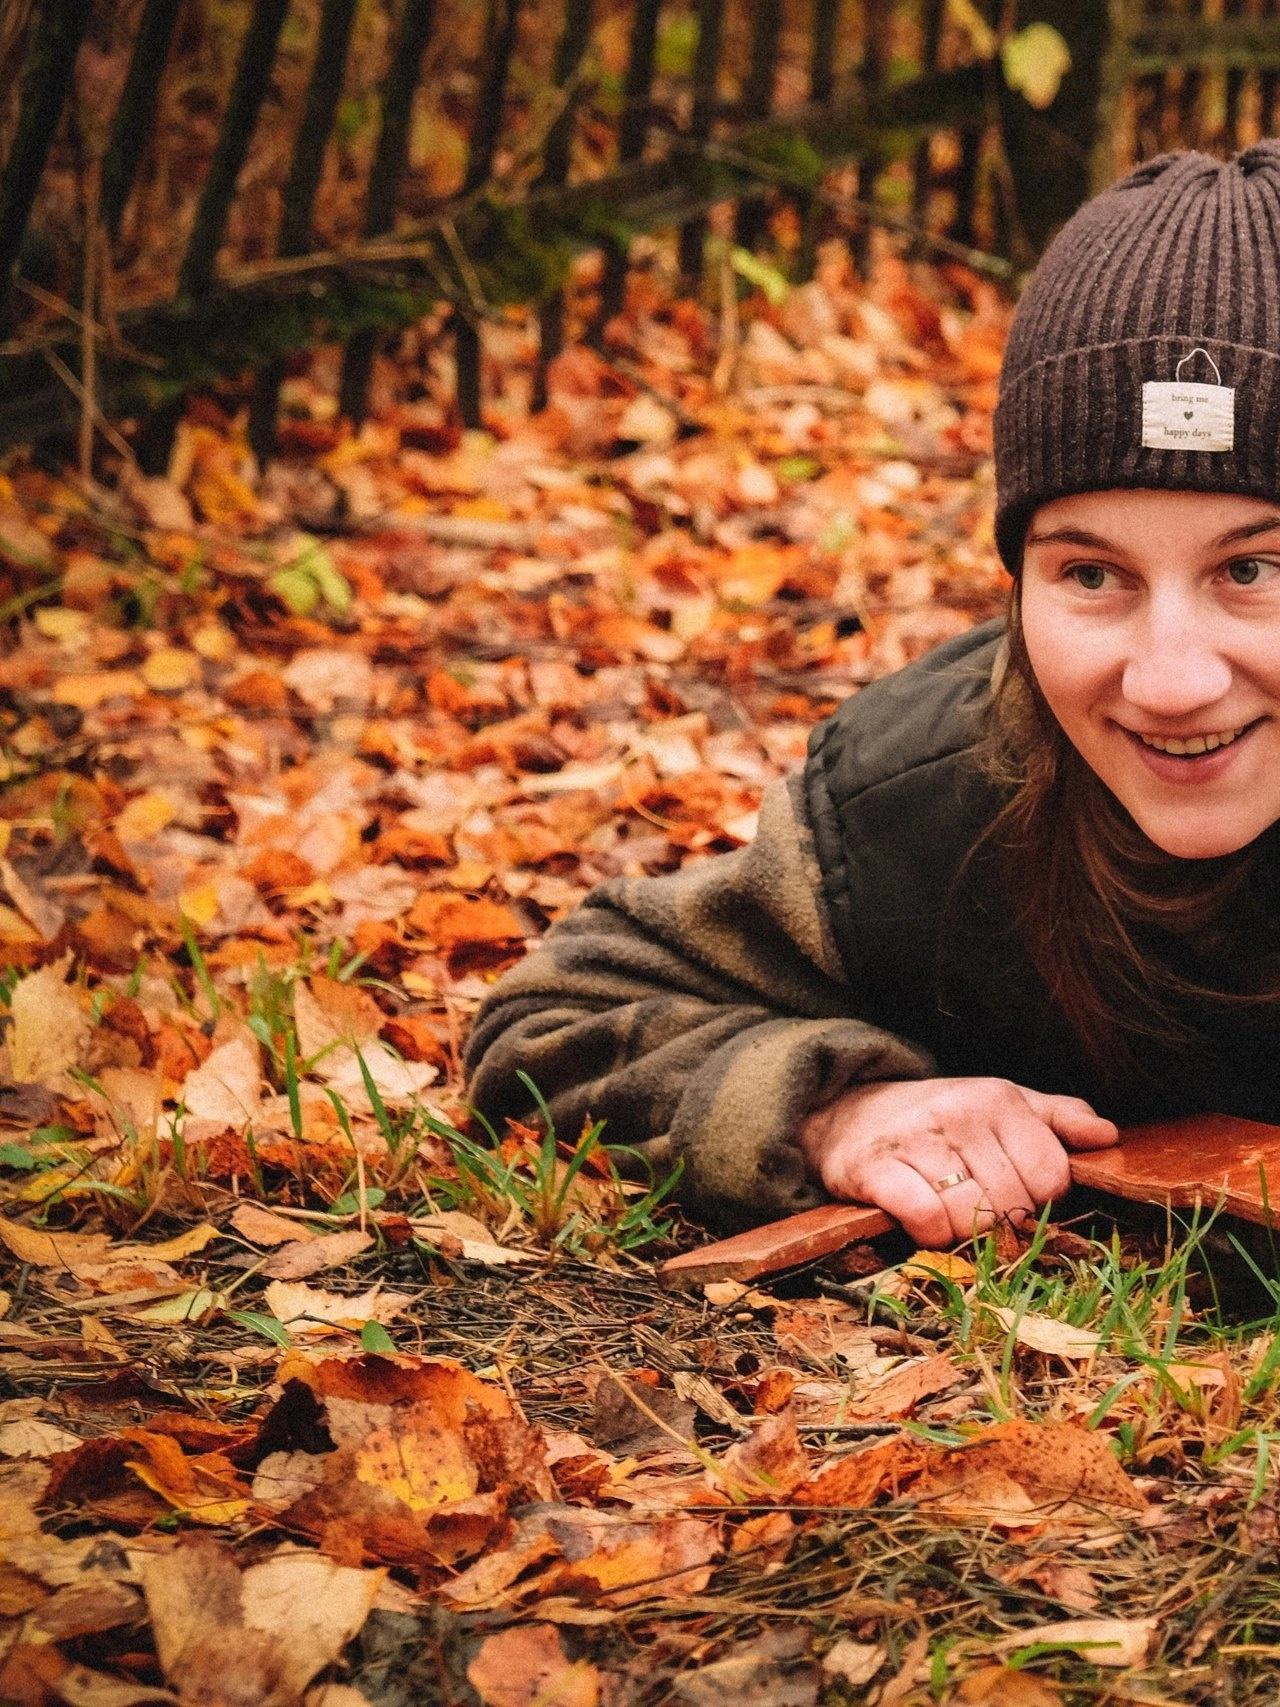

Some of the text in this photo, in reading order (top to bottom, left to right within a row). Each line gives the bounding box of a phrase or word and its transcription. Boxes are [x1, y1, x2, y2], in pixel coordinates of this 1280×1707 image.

[1171, 394, 1193, 404] bring
[1163, 427, 1211, 439] happy days
